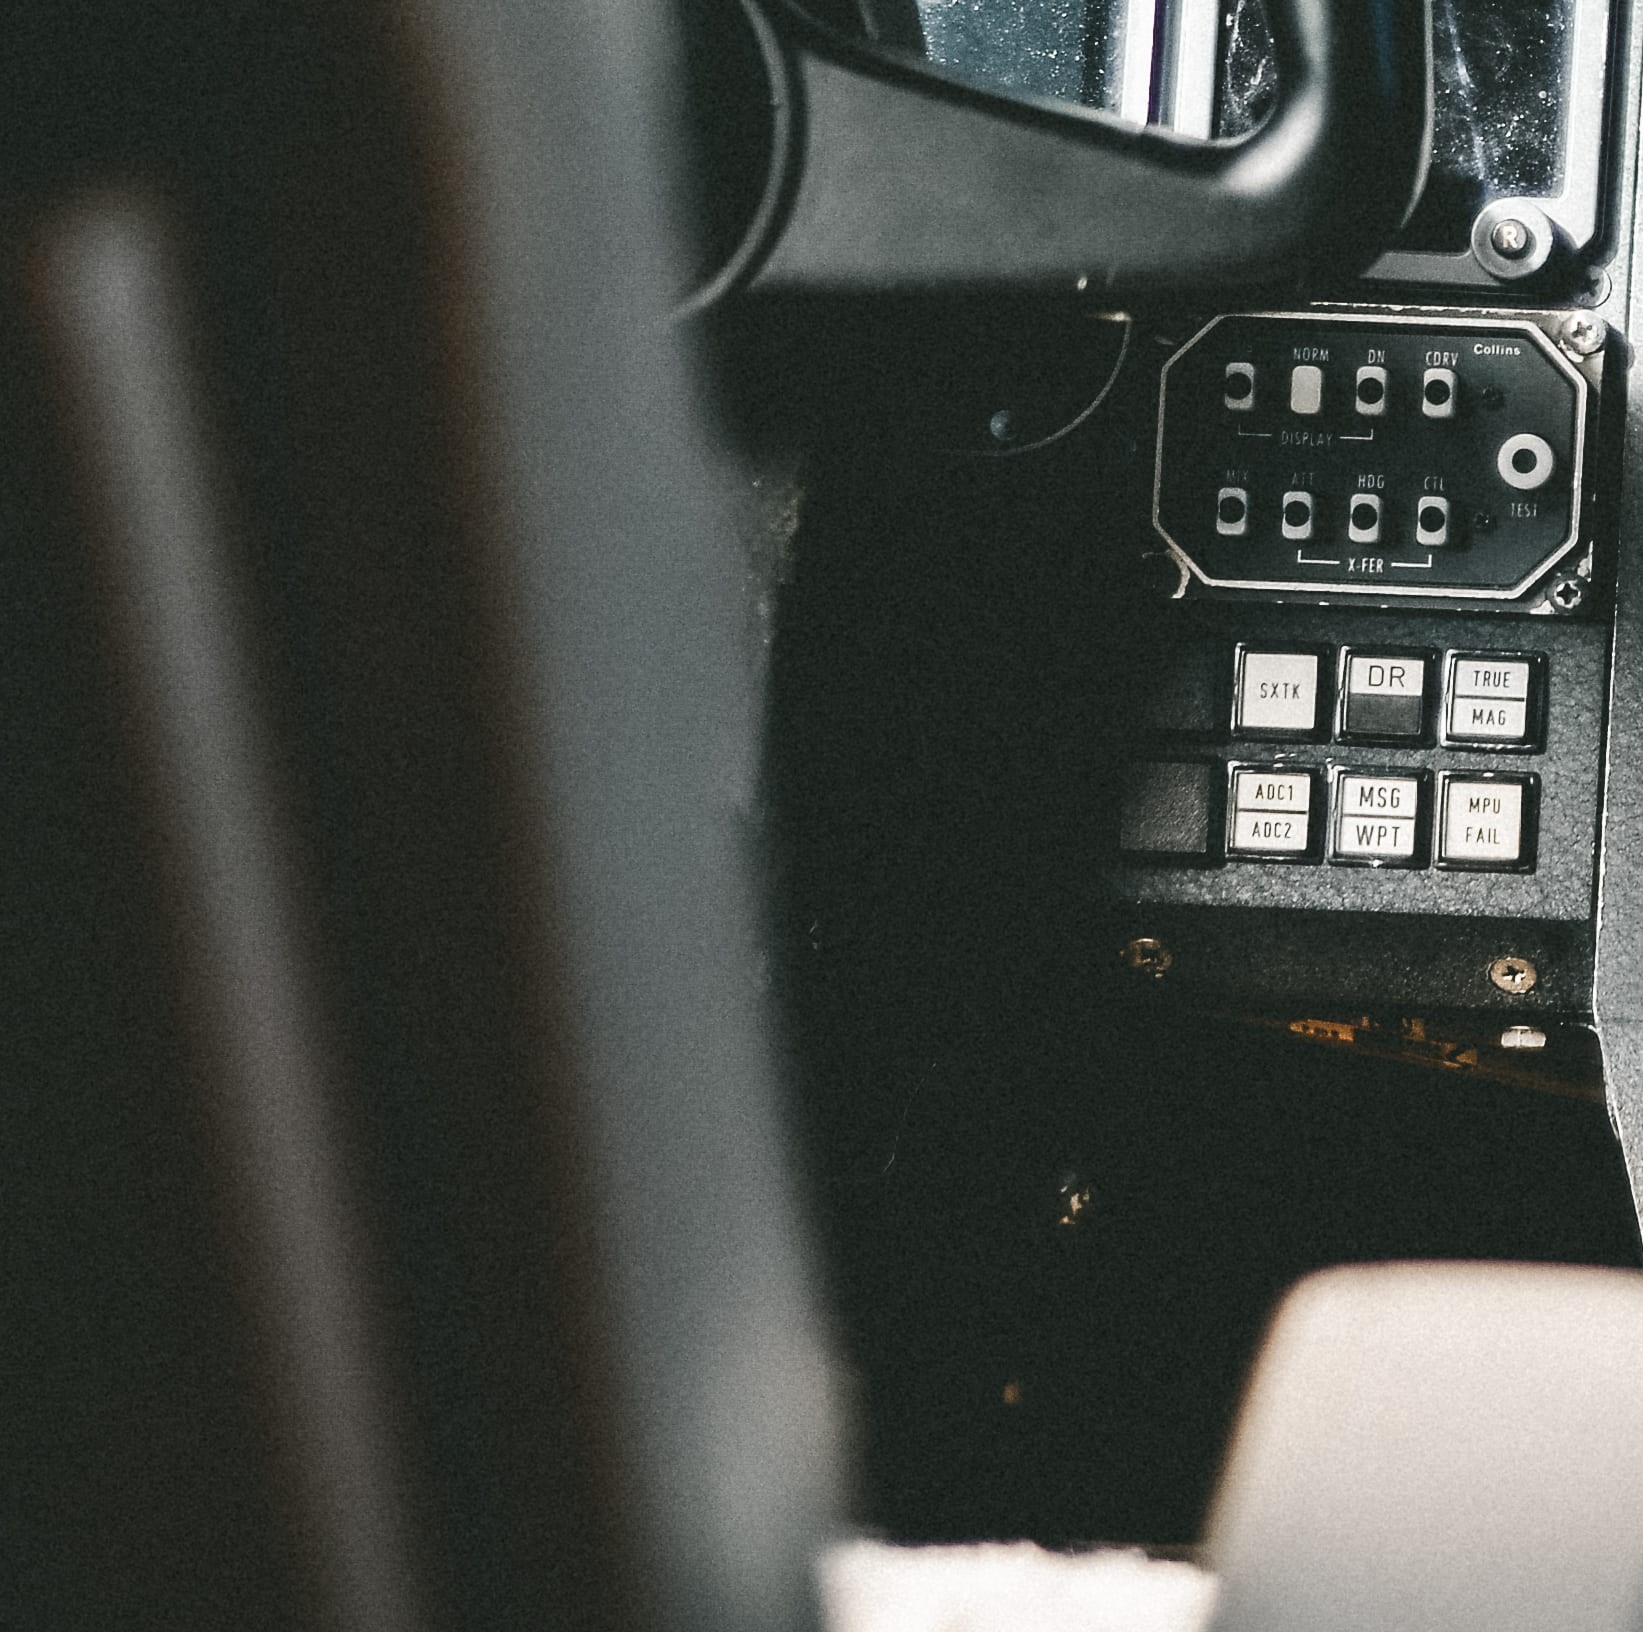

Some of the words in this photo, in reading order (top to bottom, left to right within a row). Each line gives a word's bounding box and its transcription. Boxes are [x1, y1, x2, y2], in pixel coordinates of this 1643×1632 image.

[1368, 665, 1405, 688] DR
[1473, 671, 1510, 688] TRUE
[1260, 682, 1300, 700] SXTK
[1472, 709, 1506, 726] MAG
[1256, 784, 1294, 801] ADC1
[1360, 787, 1400, 810] MSG
[1469, 797, 1501, 813] MPU
[1252, 823, 1292, 839] ADC2
[1356, 825, 1401, 847] WPT
[1466, 827, 1502, 844] FAIL
